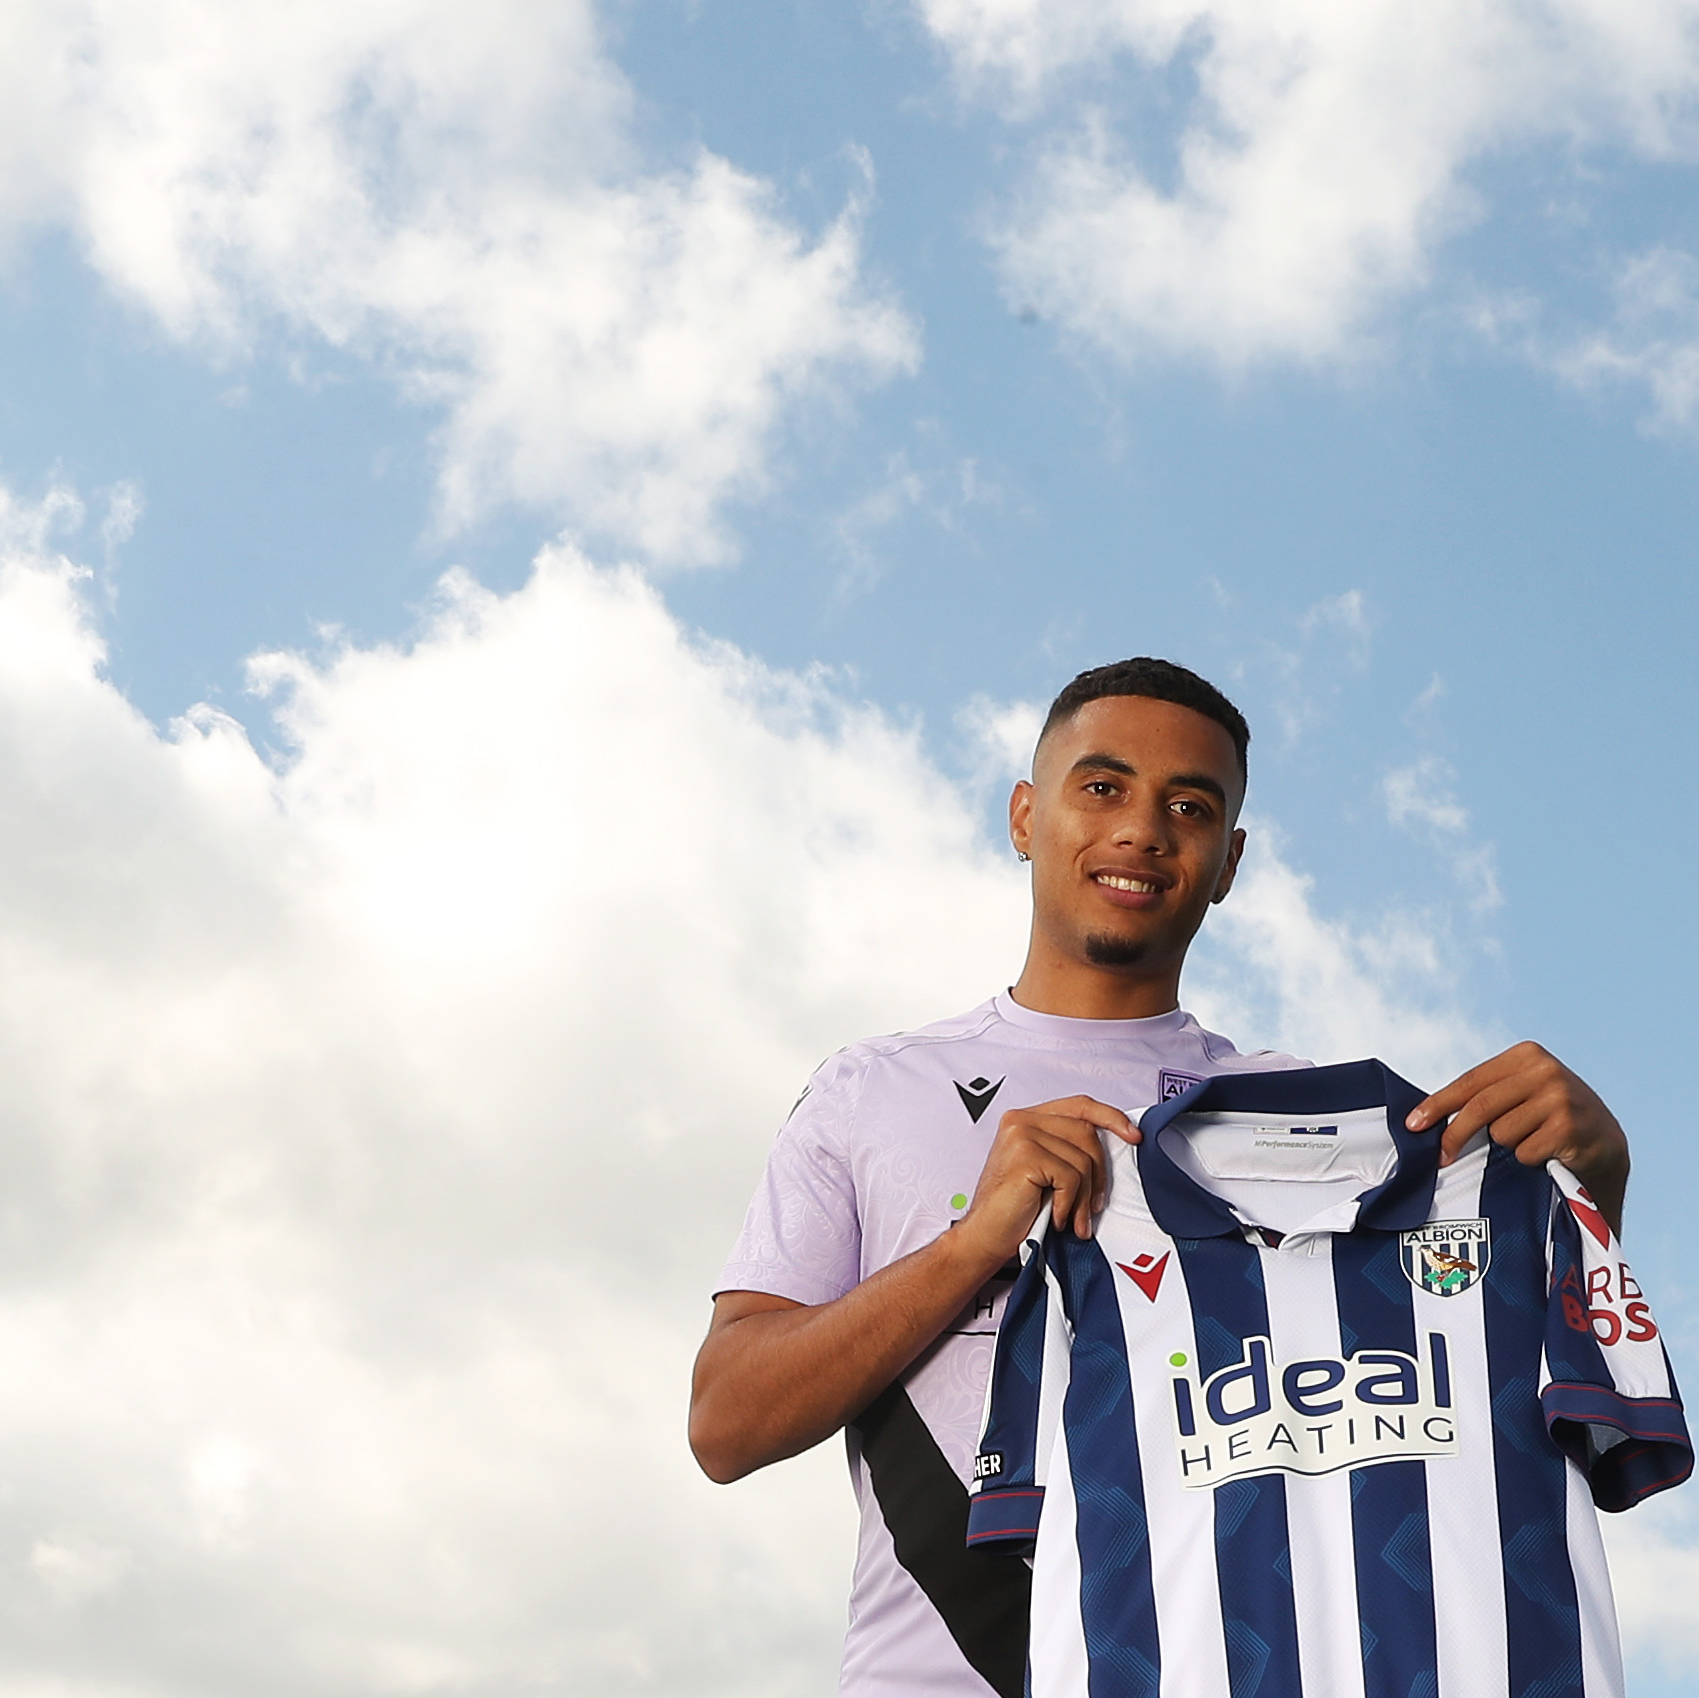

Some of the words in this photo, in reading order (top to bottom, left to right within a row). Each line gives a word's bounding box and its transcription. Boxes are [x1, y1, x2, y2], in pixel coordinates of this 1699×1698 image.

[1407, 1228, 1482, 1243] ALBION
[1169, 1332, 1452, 1436] ideal
[1181, 1414, 1454, 1476] HEATING
